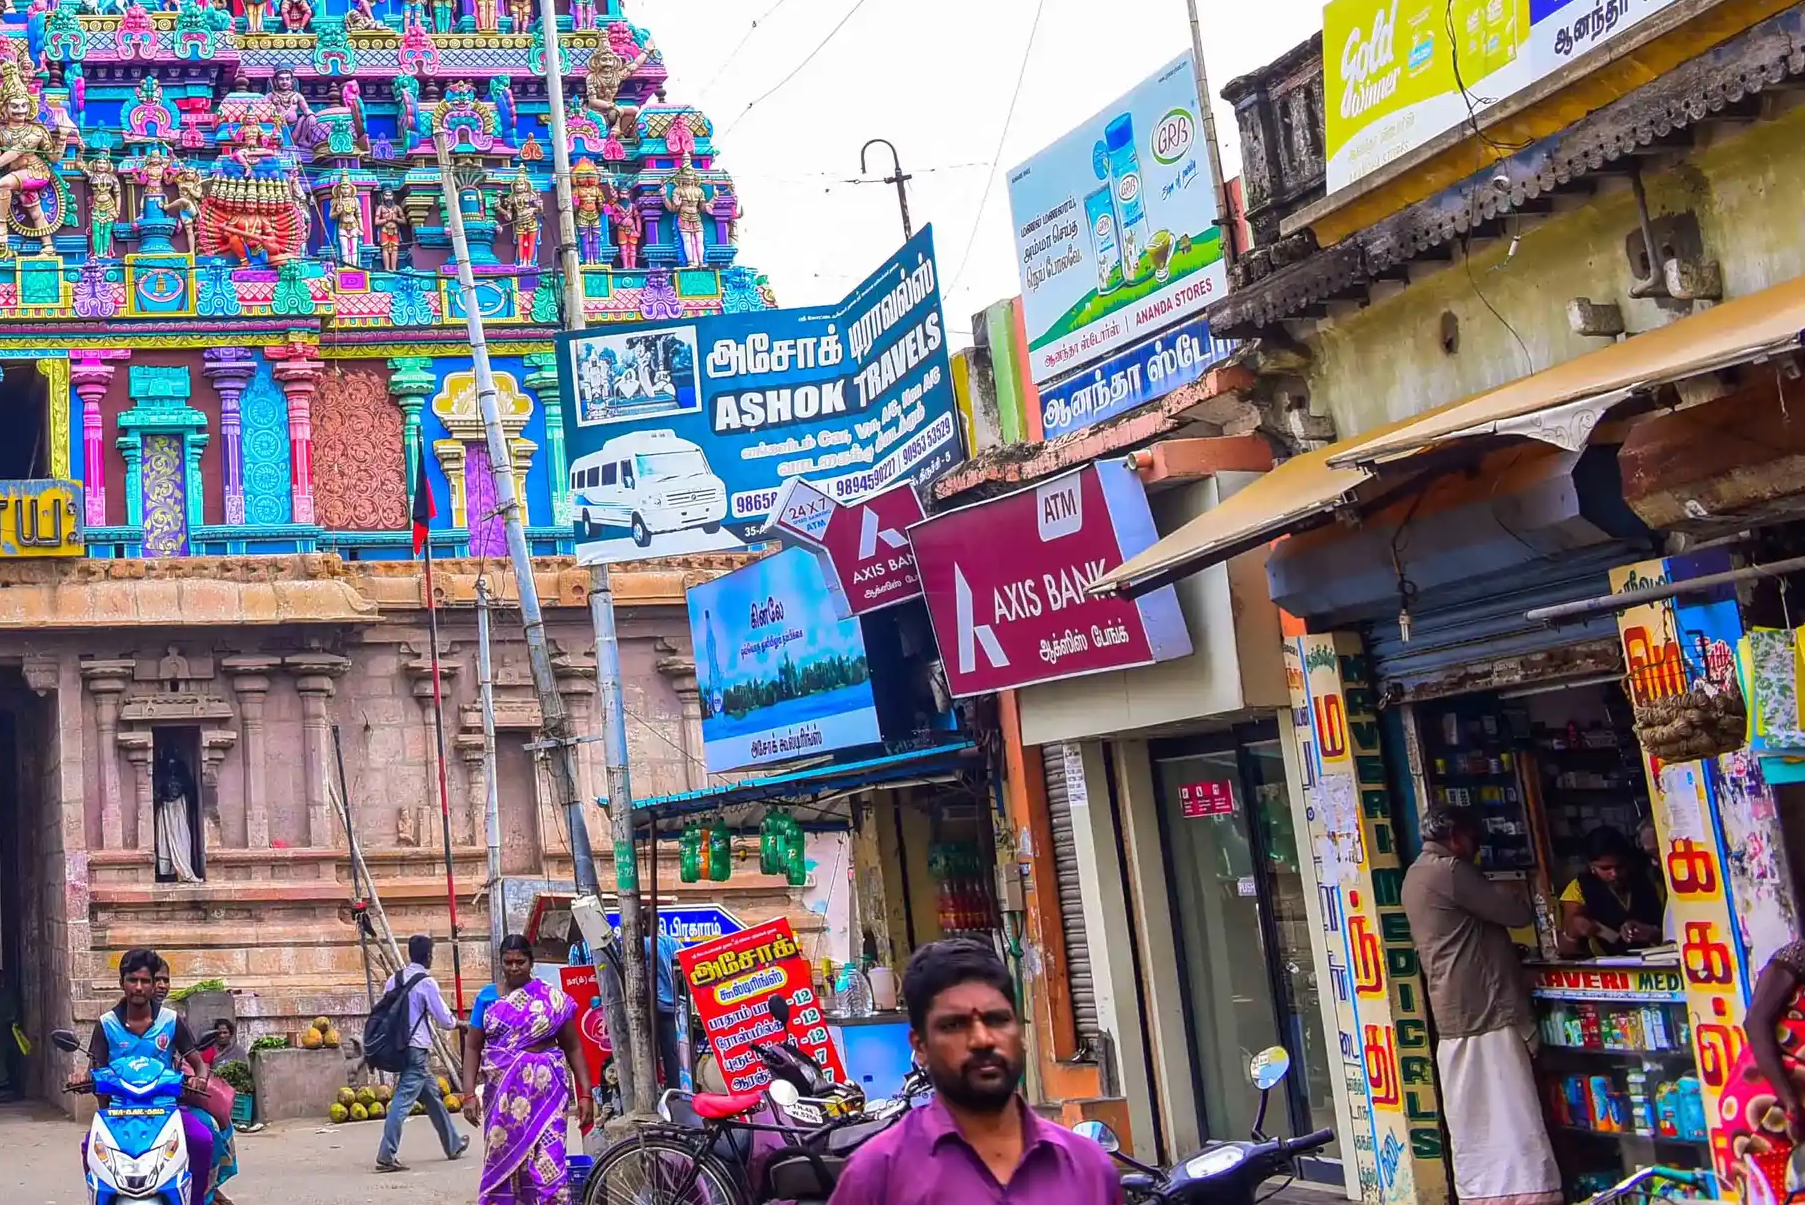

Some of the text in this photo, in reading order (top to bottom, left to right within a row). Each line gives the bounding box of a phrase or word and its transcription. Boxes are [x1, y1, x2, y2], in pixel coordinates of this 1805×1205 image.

[1340, 66, 1401, 120] Winner
[706, 324, 843, 378] அசோக்
[848, 252, 935, 364] டிராவல்ஸ்
[1135, 277, 1213, 327] ANANDA STORES
[715, 312, 942, 431] ASHOK TRAVELS
[1044, 344, 1079, 368] ஆனந்தா
[1043, 362, 1141, 429] ஆனந்தா
[835, 459, 896, 497] 9894590227
[902, 440, 927, 467] 90953
[926, 417, 952, 448] 53529
[789, 498, 827, 520] 24 X 7
[806, 519, 827, 532] ATM
[1045, 489, 1077, 524] ATM
[853, 563, 886, 584] AXIS
[994, 578, 1042, 625] AXIS
[1090, 618, 1129, 648] பேங்க்
[669, 916, 722, 939] பிரகாரம்
[690, 933, 800, 986] அசோக்
[708, 1005, 751, 1030] பாதாம்
[752, 1001, 771, 1017] பா
[1369, 867, 1443, 1160] MEDICALS
